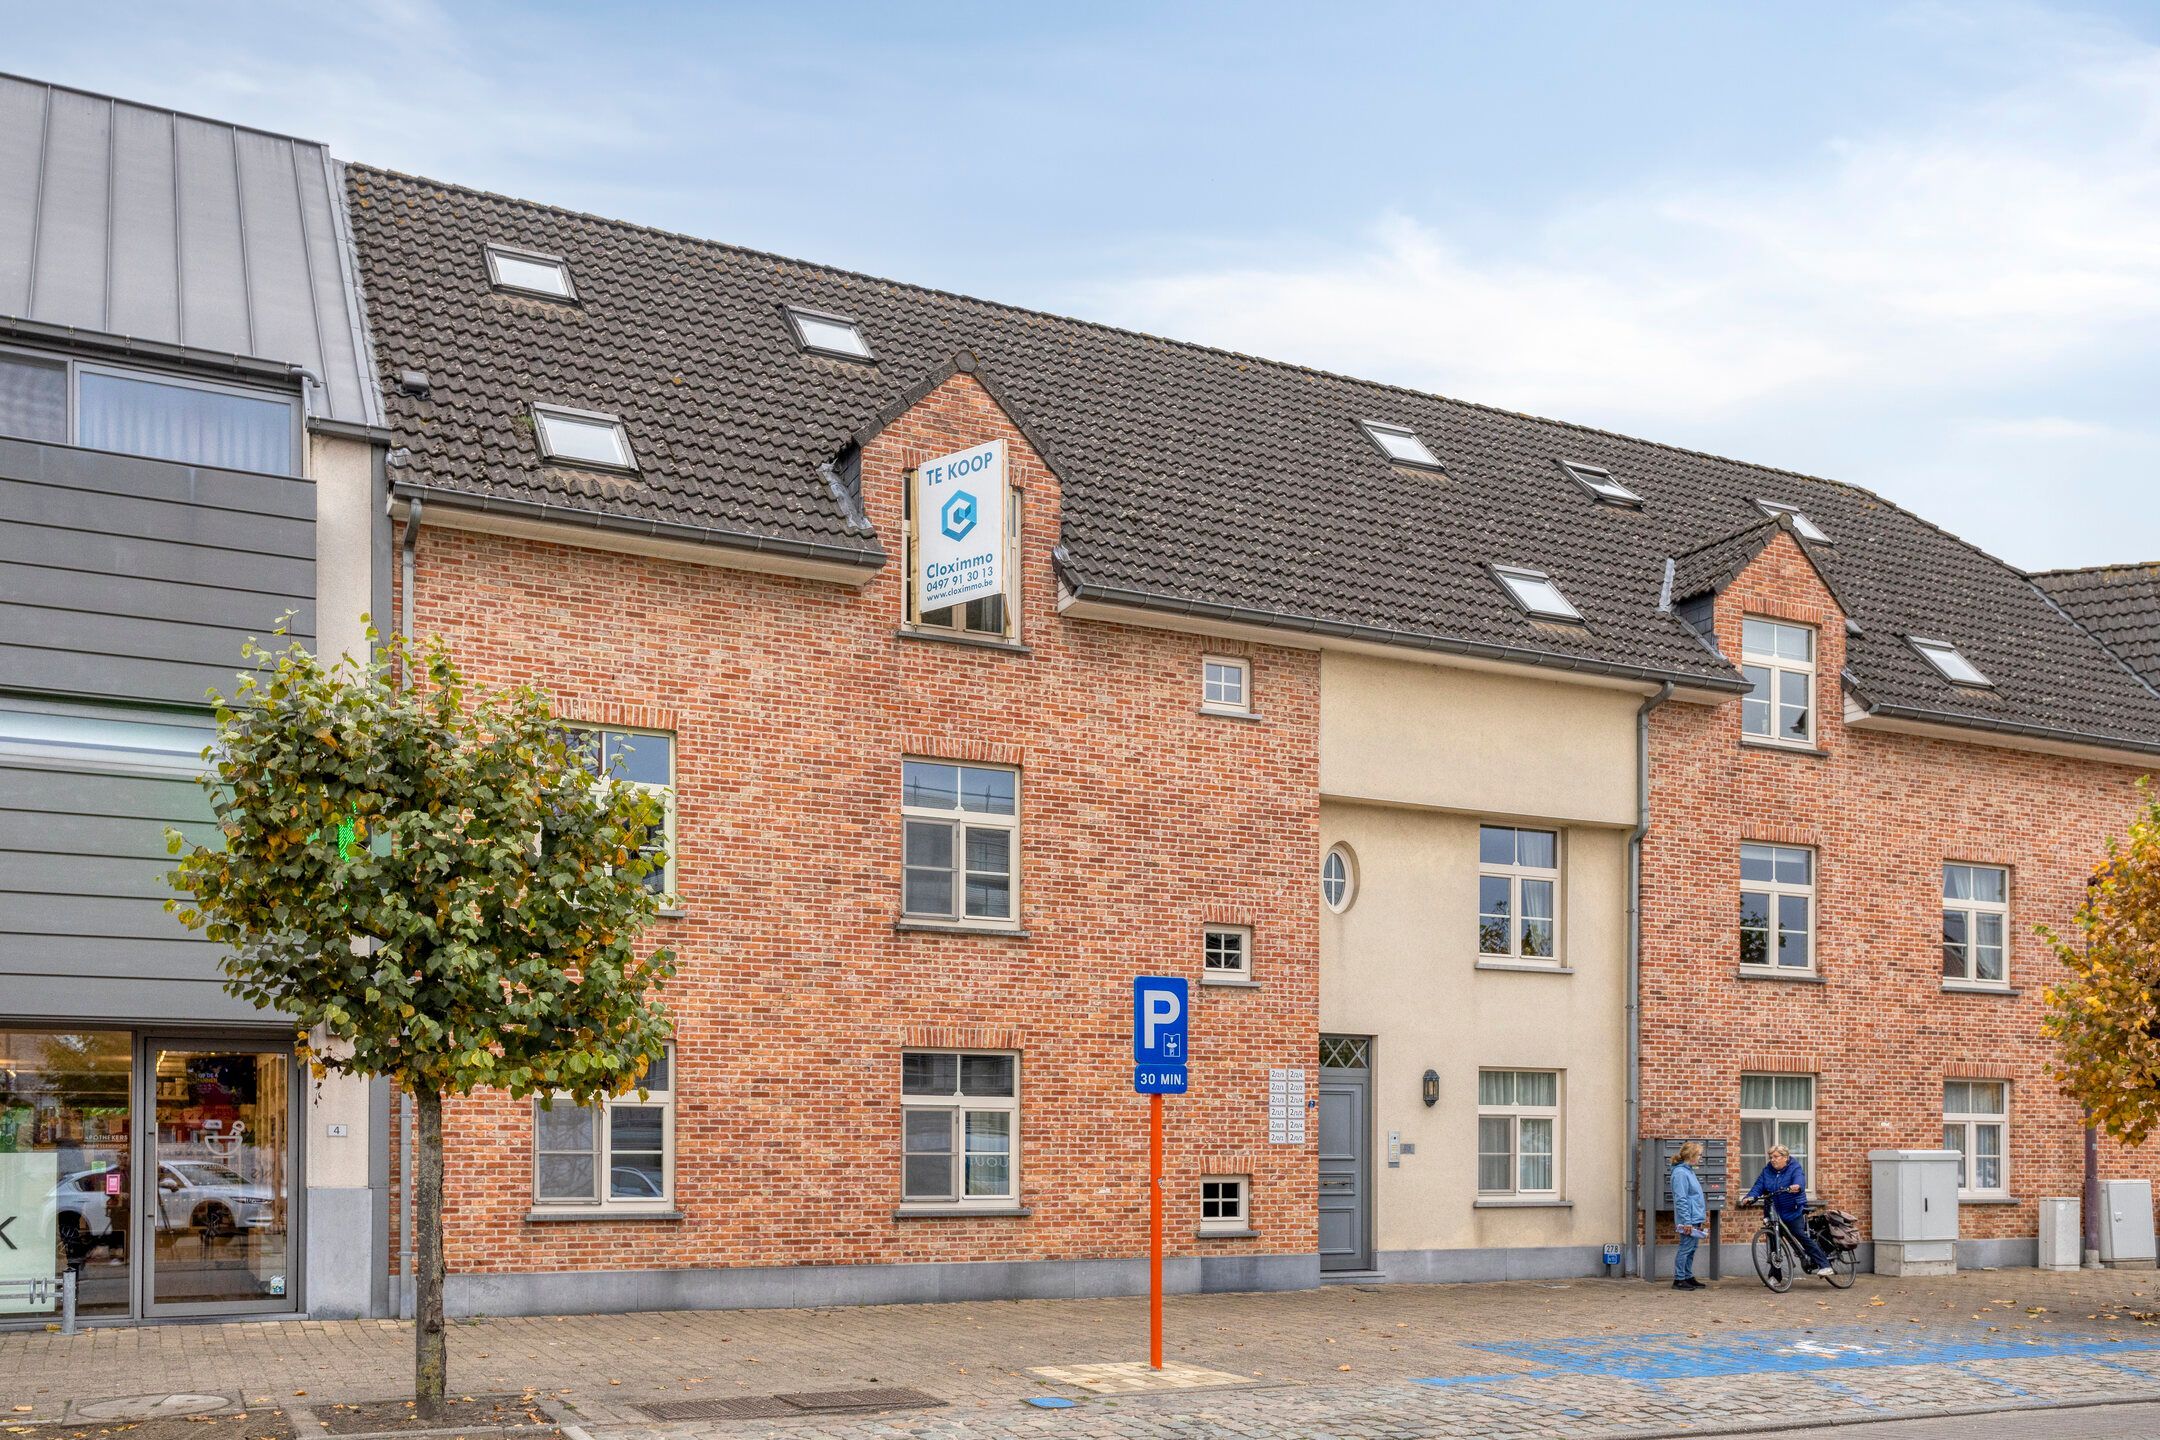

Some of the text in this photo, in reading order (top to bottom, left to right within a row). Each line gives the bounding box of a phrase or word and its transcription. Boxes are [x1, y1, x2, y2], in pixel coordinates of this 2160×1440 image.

[926, 452, 993, 486] TE KOOP
[926, 553, 993, 578] Cloximmo
[926, 566, 993, 592] 0497 91 30 13
[926, 579, 993, 601] www.cloximmo.be
[1144, 990, 1180, 1049] P
[1140, 1073, 1185, 1085] 30 MIN.
[333, 1126, 340, 1134] 4
